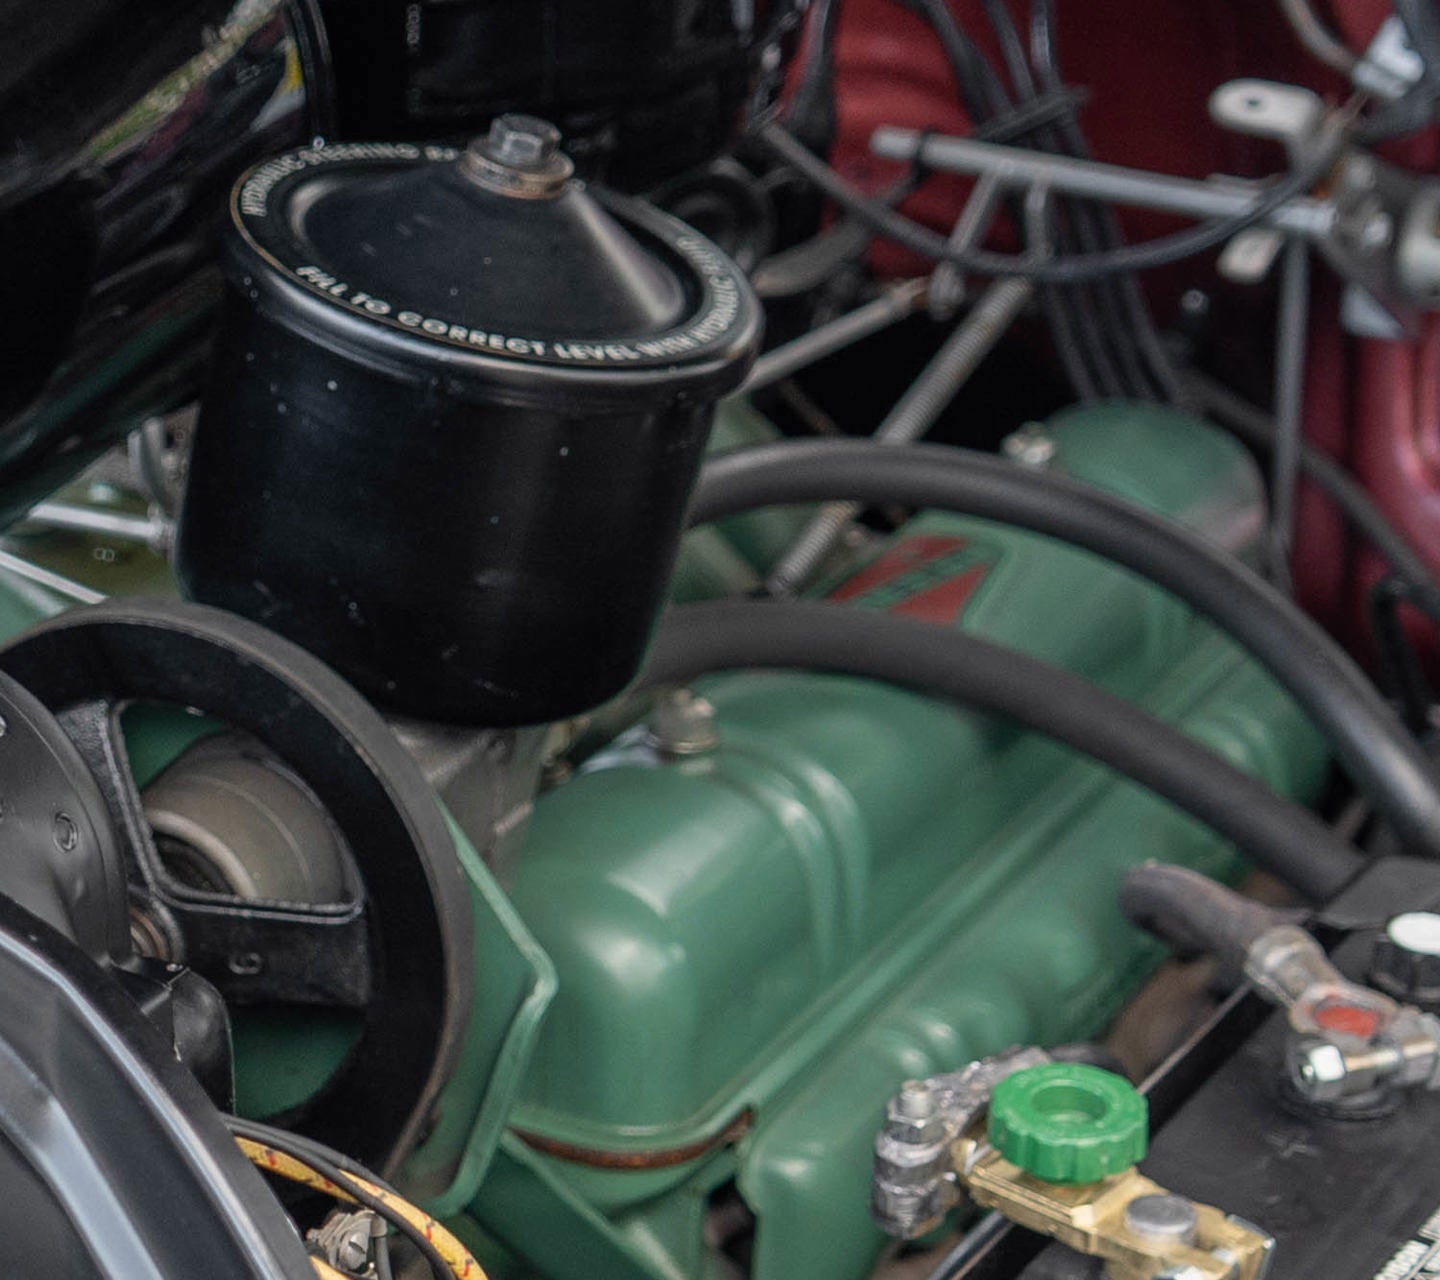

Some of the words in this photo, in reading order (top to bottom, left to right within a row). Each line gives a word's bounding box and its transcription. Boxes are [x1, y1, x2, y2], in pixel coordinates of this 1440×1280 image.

[296, 265, 348, 297] FILL
[350, 291, 392, 316] TO
[397, 310, 546, 356] CORRECT
[553, 340, 640, 361] LEVEL
